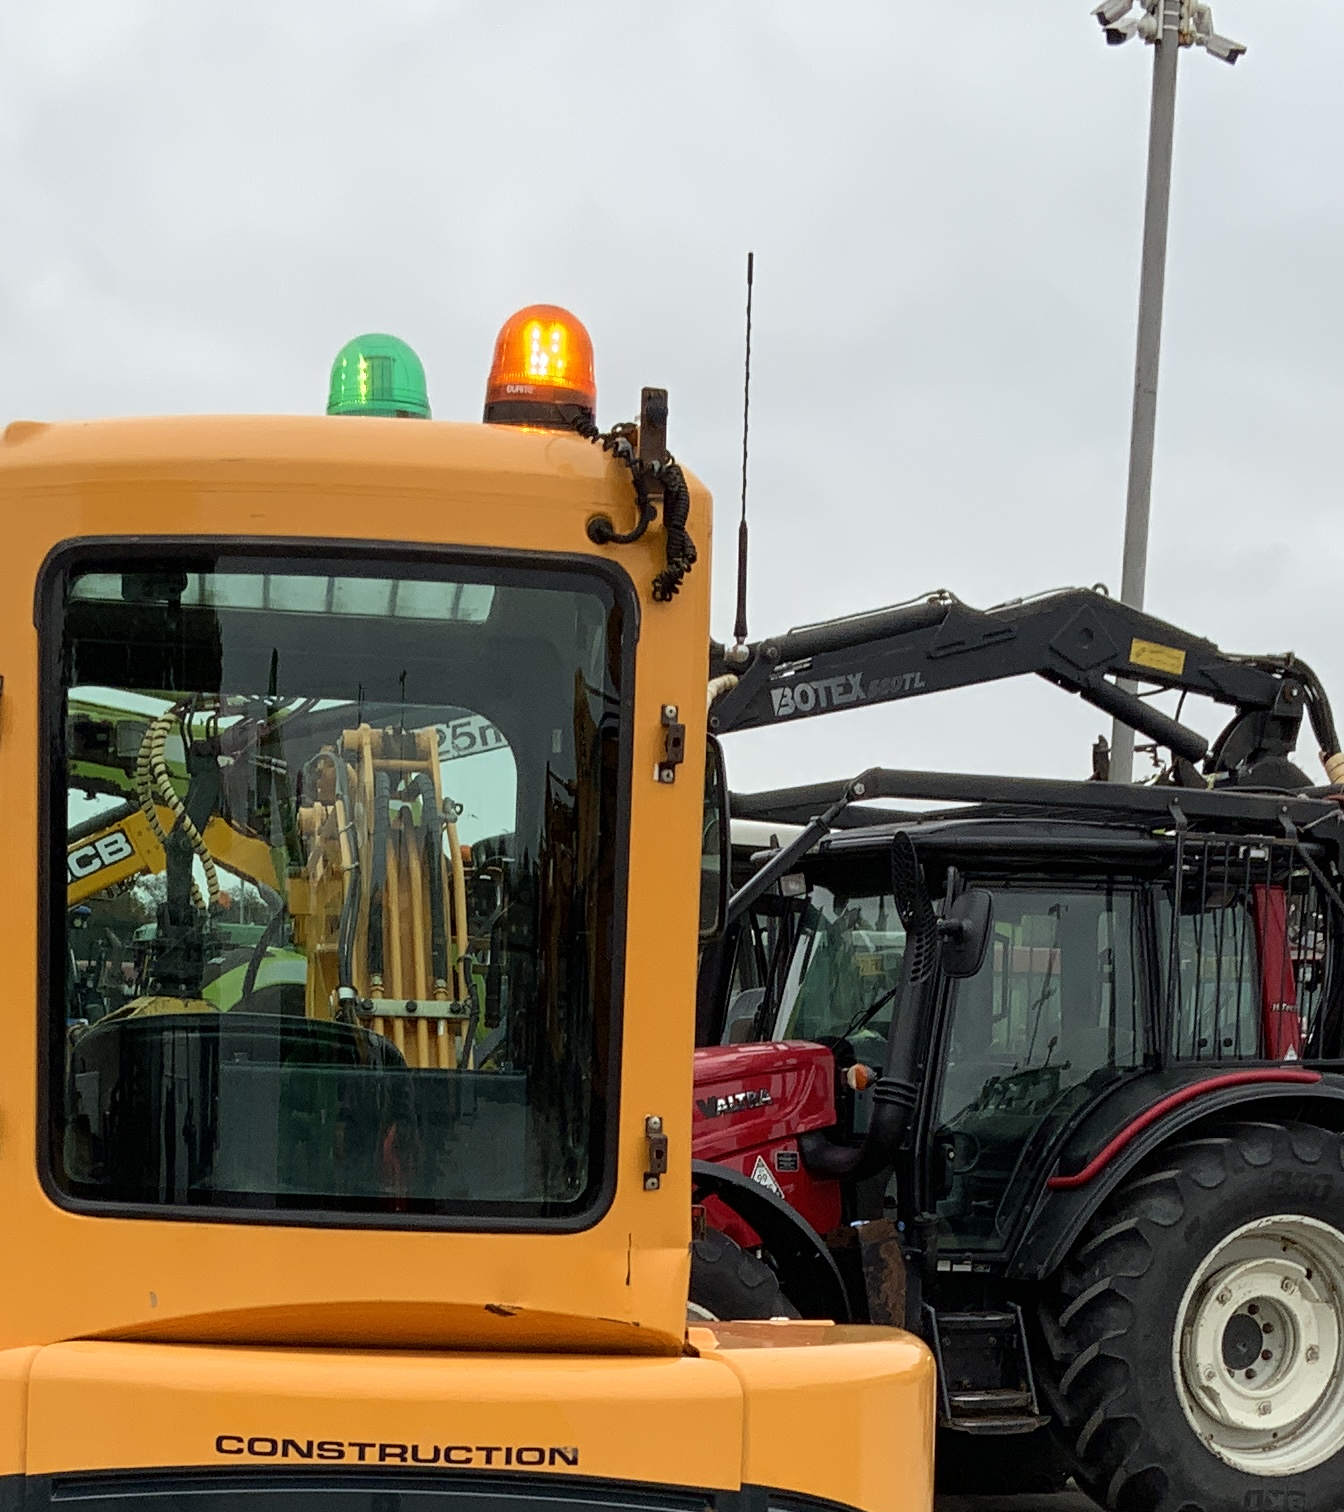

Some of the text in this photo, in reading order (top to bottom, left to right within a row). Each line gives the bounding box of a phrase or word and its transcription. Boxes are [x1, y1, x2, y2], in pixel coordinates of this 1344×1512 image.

[770, 672, 867, 716] BOTEX
[67, 831, 133, 883] CB
[697, 1088, 773, 1118] VALTRA
[215, 1434, 580, 1467] CONSTRUCTION
